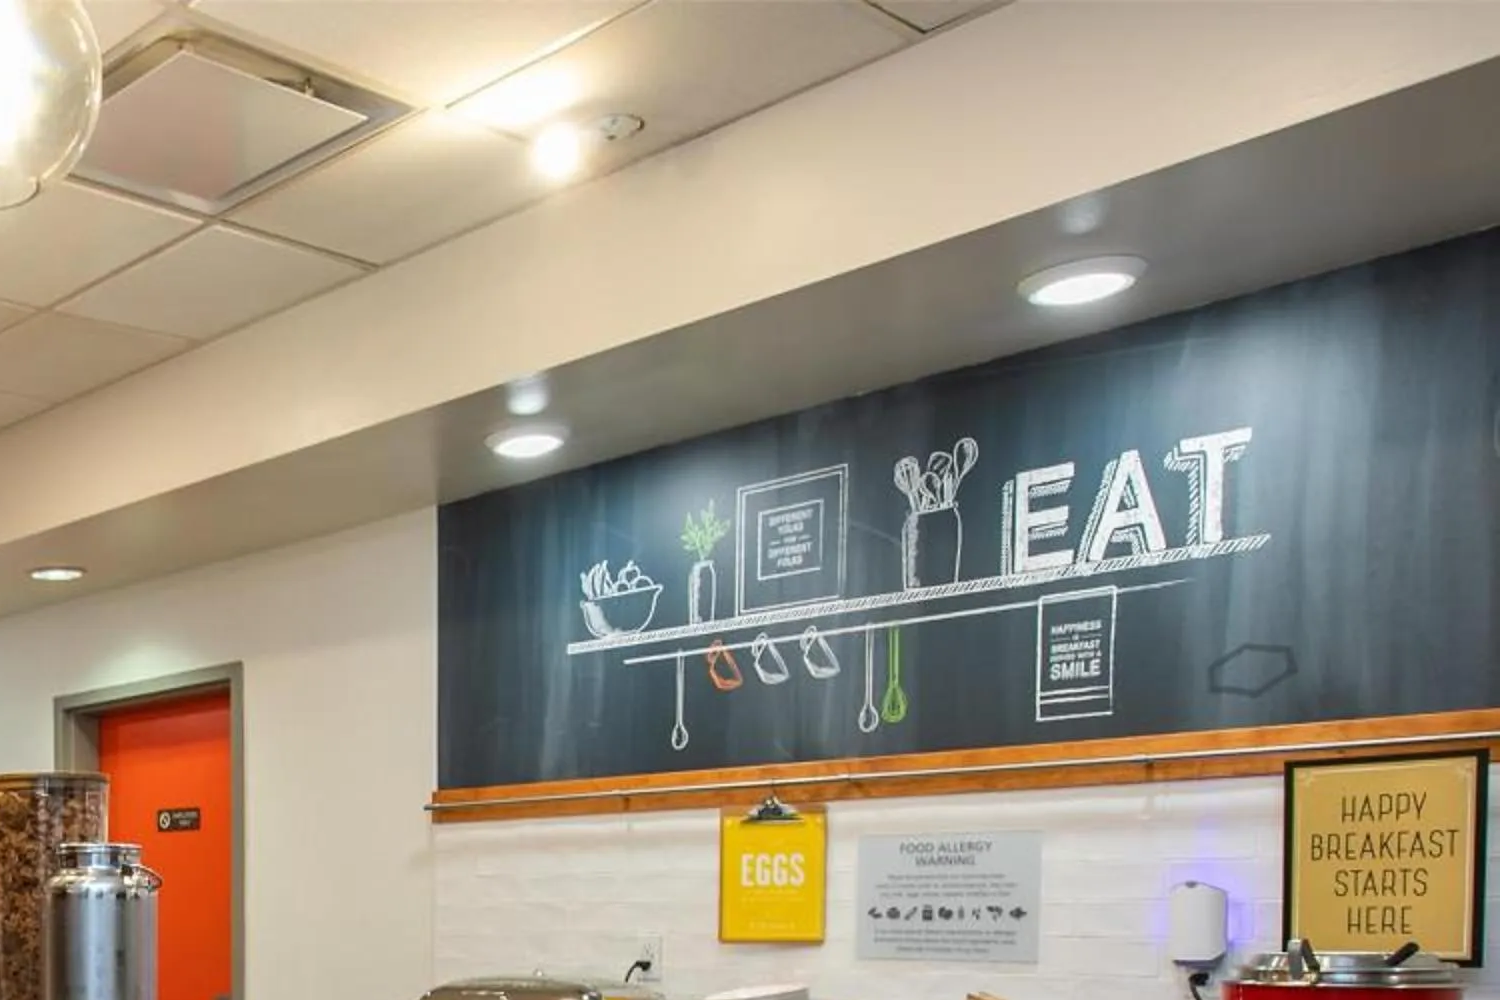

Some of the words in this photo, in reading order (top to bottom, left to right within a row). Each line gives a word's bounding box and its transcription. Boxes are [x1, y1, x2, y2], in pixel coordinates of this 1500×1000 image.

[1001, 427, 1253, 576] EAT
[1051, 639, 1100, 654] BREAKFAST
[1050, 659, 1102, 680] SMILE
[1341, 791, 1427, 824] HAPPY
[899, 842, 935, 854] FOOD
[938, 841, 993, 853] ALLERGY
[1311, 829, 1460, 861] BREAKFAST
[741, 852, 805, 887] EGGS
[914, 855, 976, 866] WARNING
[1333, 868, 1429, 897] STARTS
[1347, 906, 1413, 935] HERE
